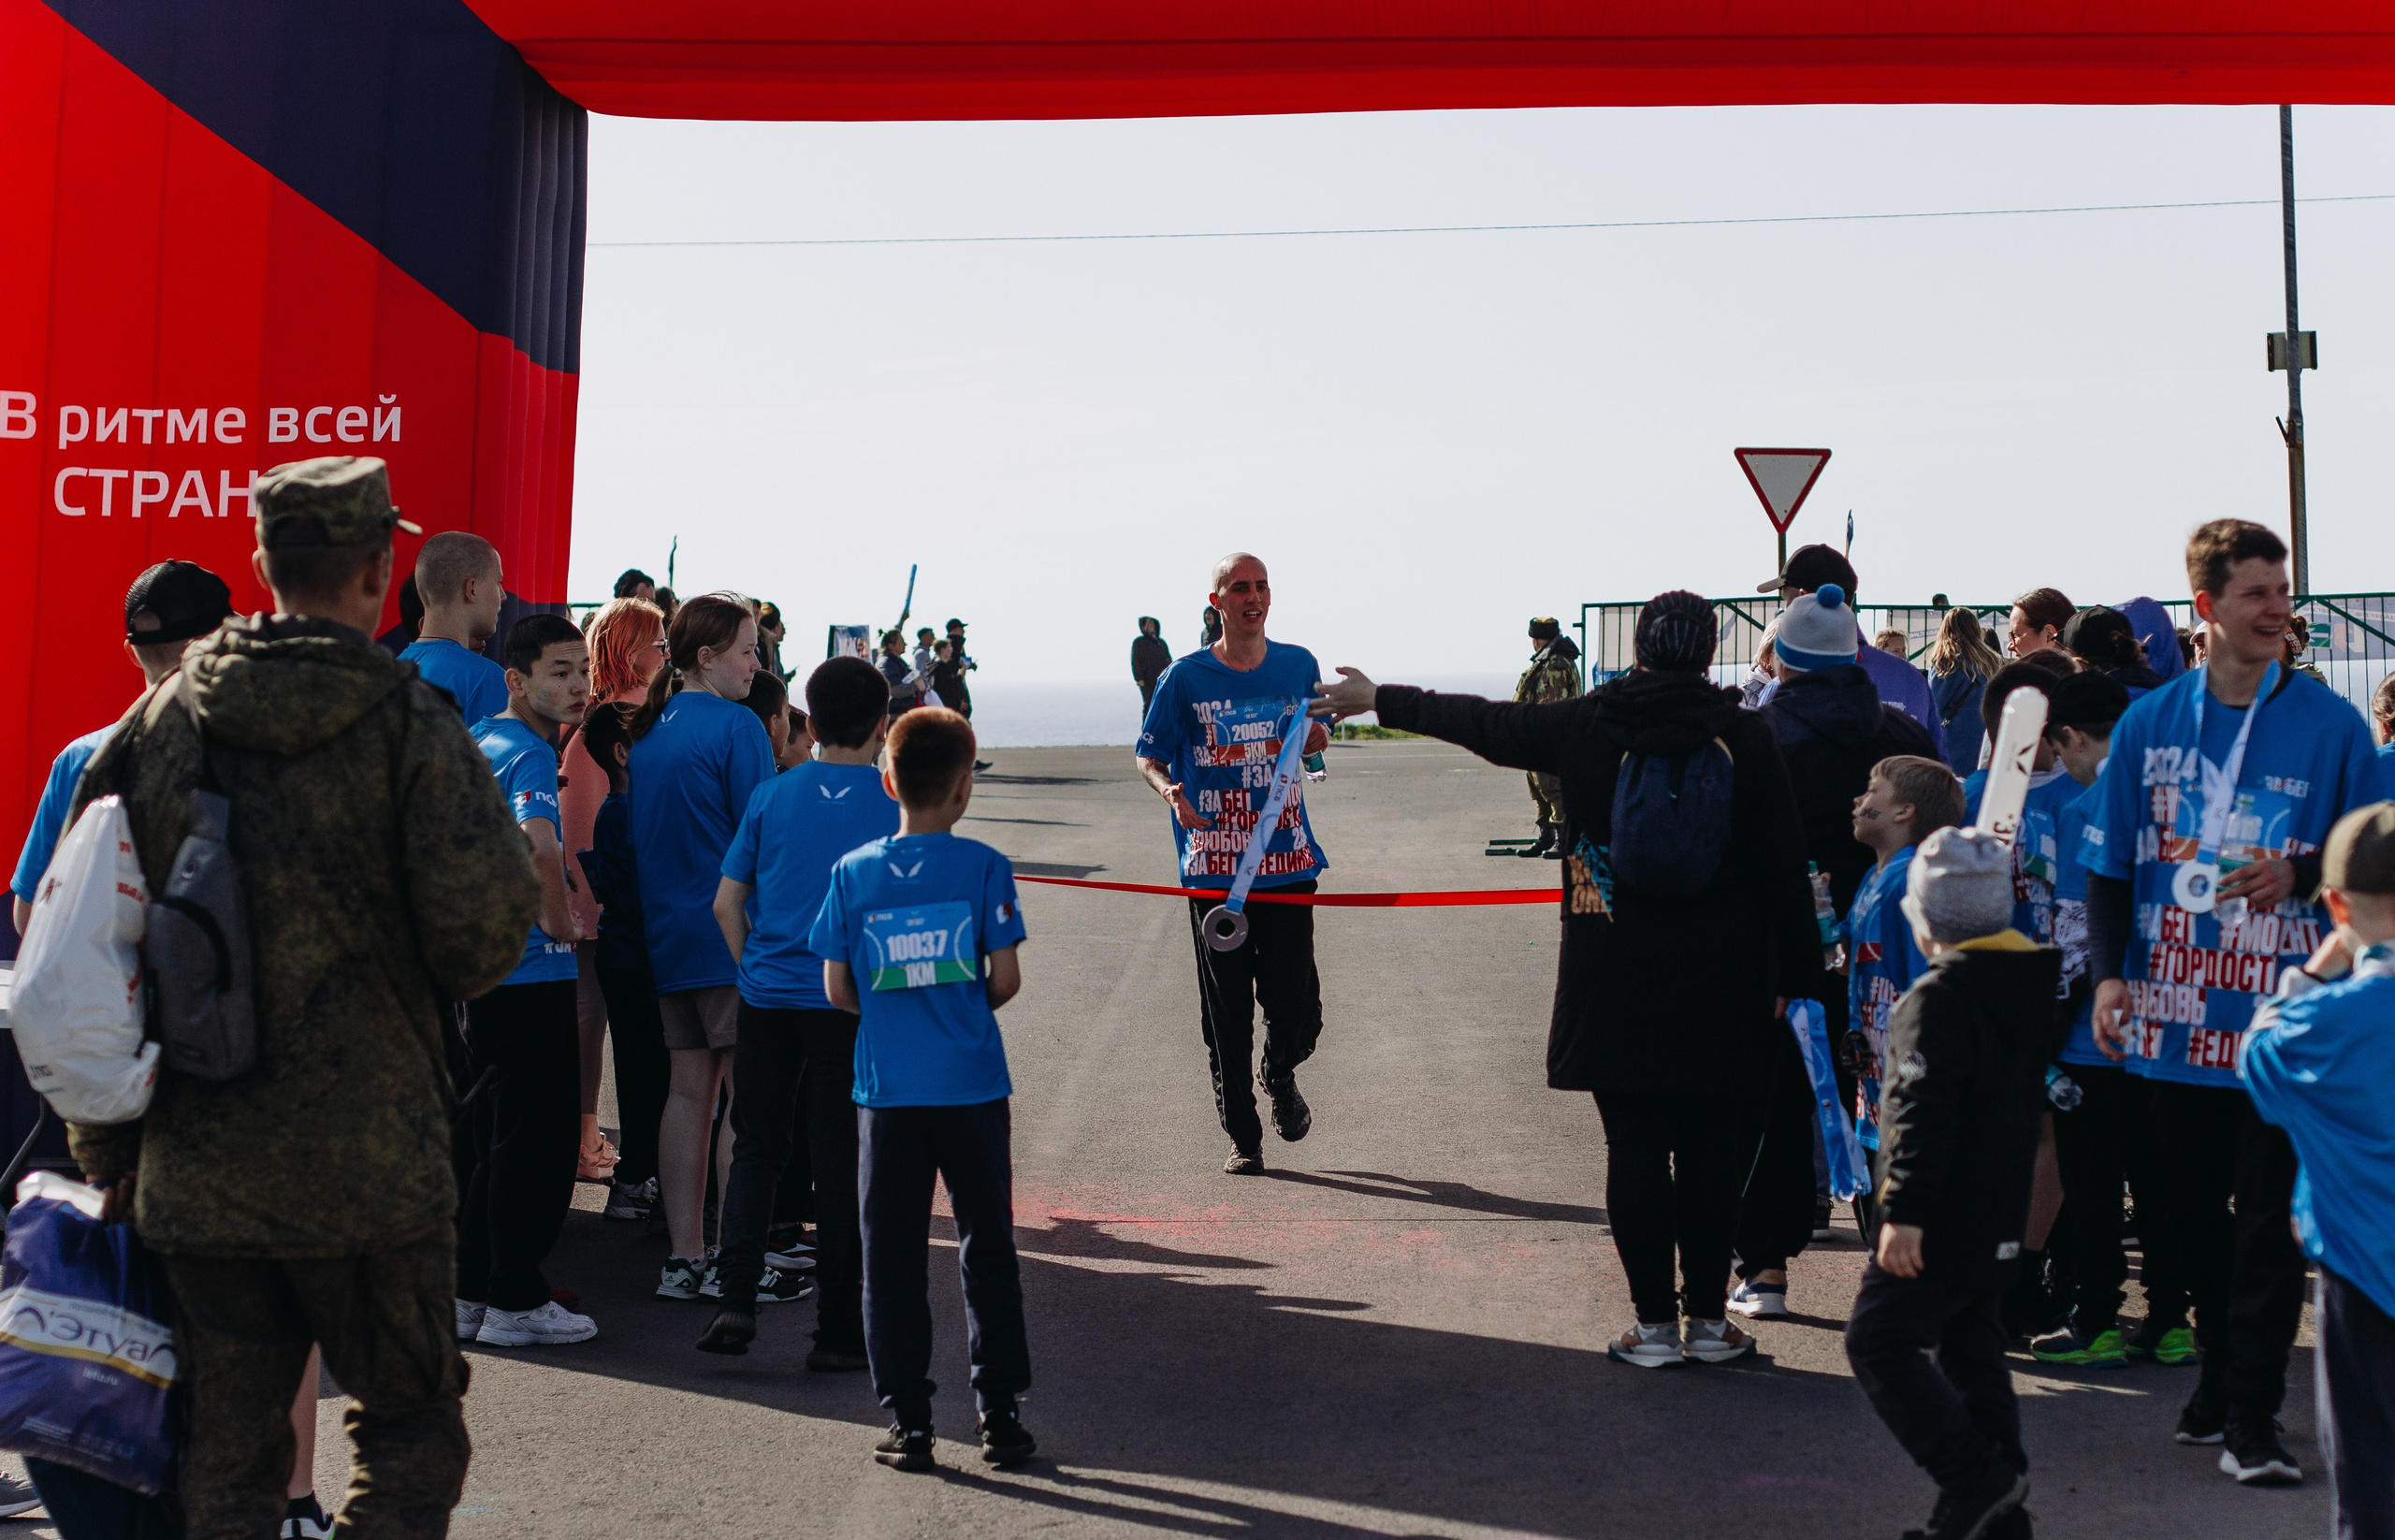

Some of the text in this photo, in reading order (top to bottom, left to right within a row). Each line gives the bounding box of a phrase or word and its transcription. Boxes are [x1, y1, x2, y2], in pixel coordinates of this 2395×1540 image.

[0, 390, 402, 449] В ритме всей
[53, 466, 258, 517] СТРАН
[1231, 719, 1275, 742] 20052
[885, 929, 948, 962] 10037
